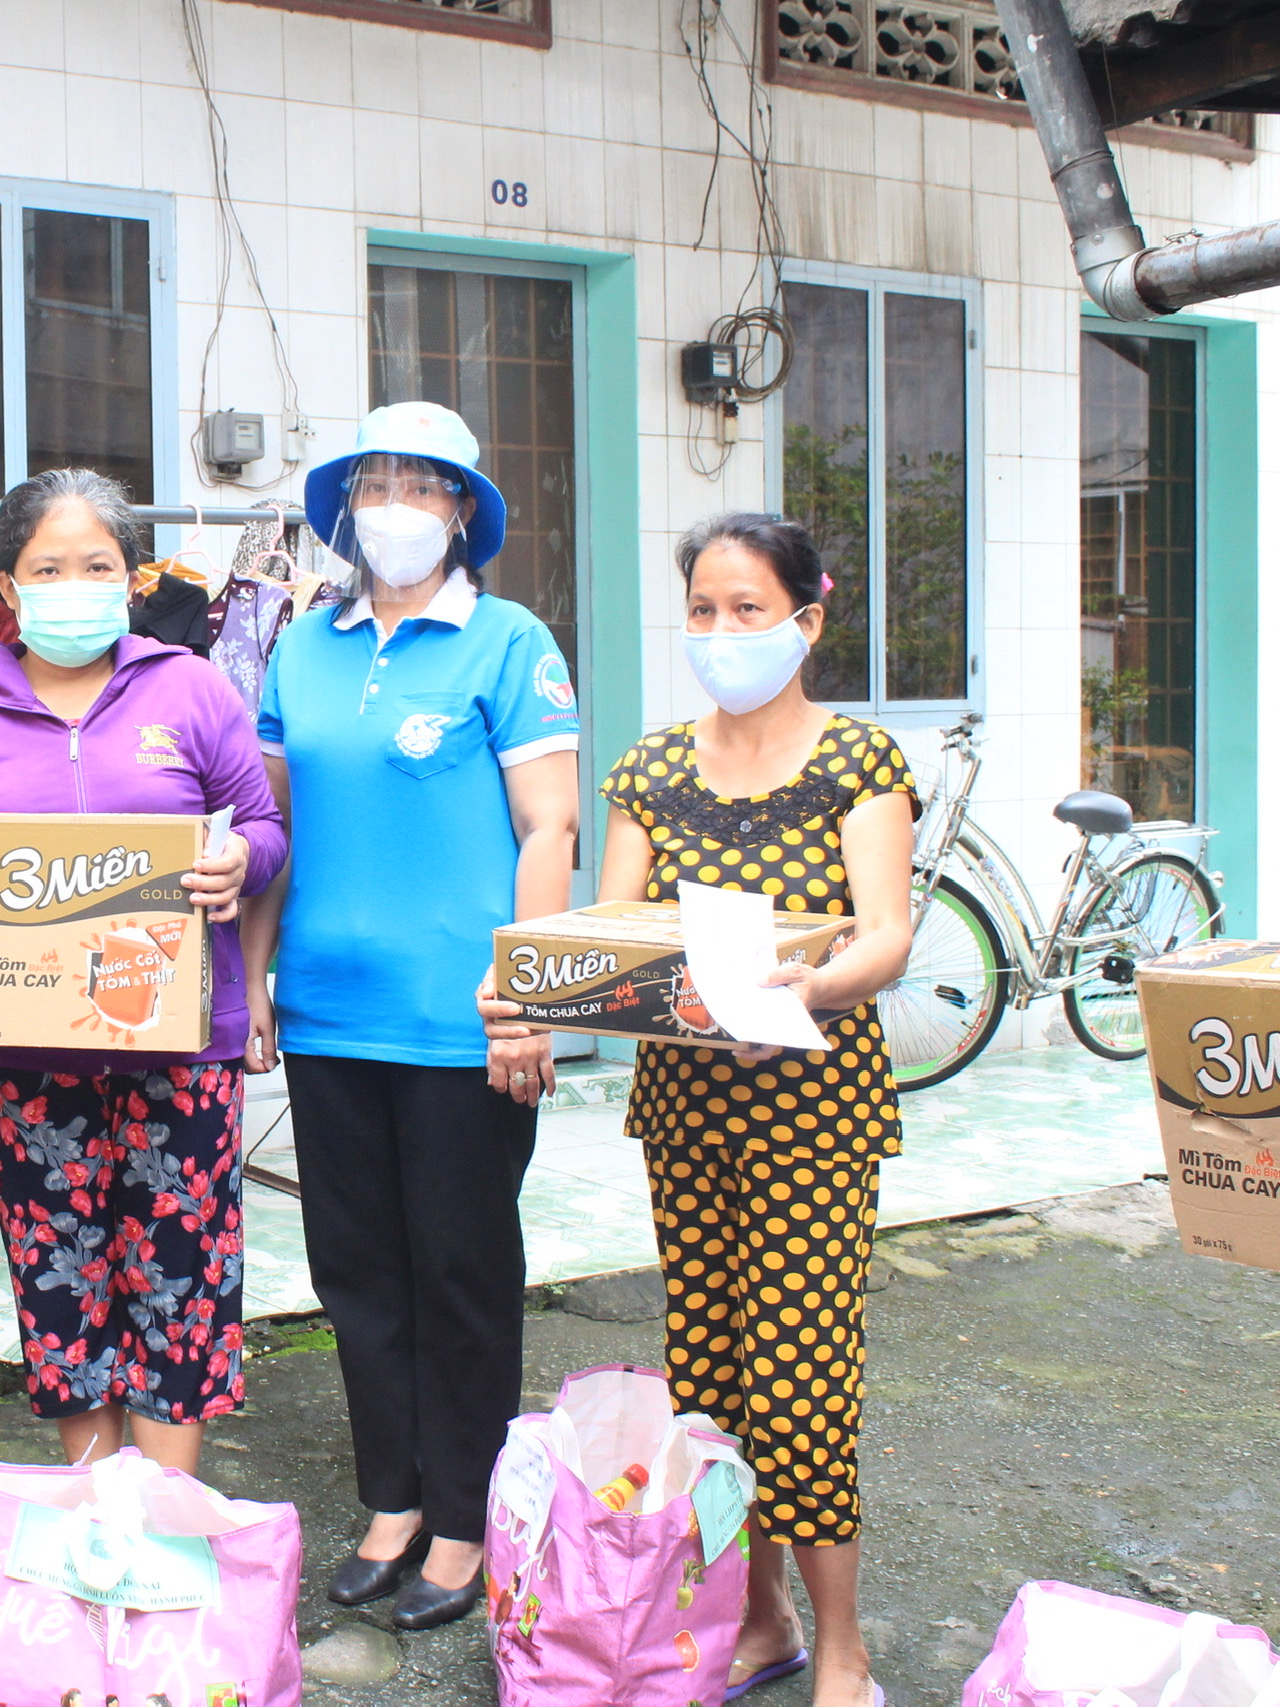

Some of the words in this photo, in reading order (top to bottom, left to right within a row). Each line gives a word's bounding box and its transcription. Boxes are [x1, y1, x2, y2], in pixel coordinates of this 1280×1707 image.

[491, 179, 528, 208] 08
[140, 889, 182, 900] GOLD
[23, 974, 62, 988] CAY
[632, 969, 661, 980] GOLD
[526, 1004, 548, 1018] TÔM
[549, 1006, 580, 1018] CHUA
[580, 1001, 602, 1016] CAY
[1178, 1148, 1200, 1168] Mì
[1202, 1151, 1241, 1173] Tôm
[1181, 1168, 1235, 1192] CHUA
[1242, 1177, 1280, 1199] CAY
